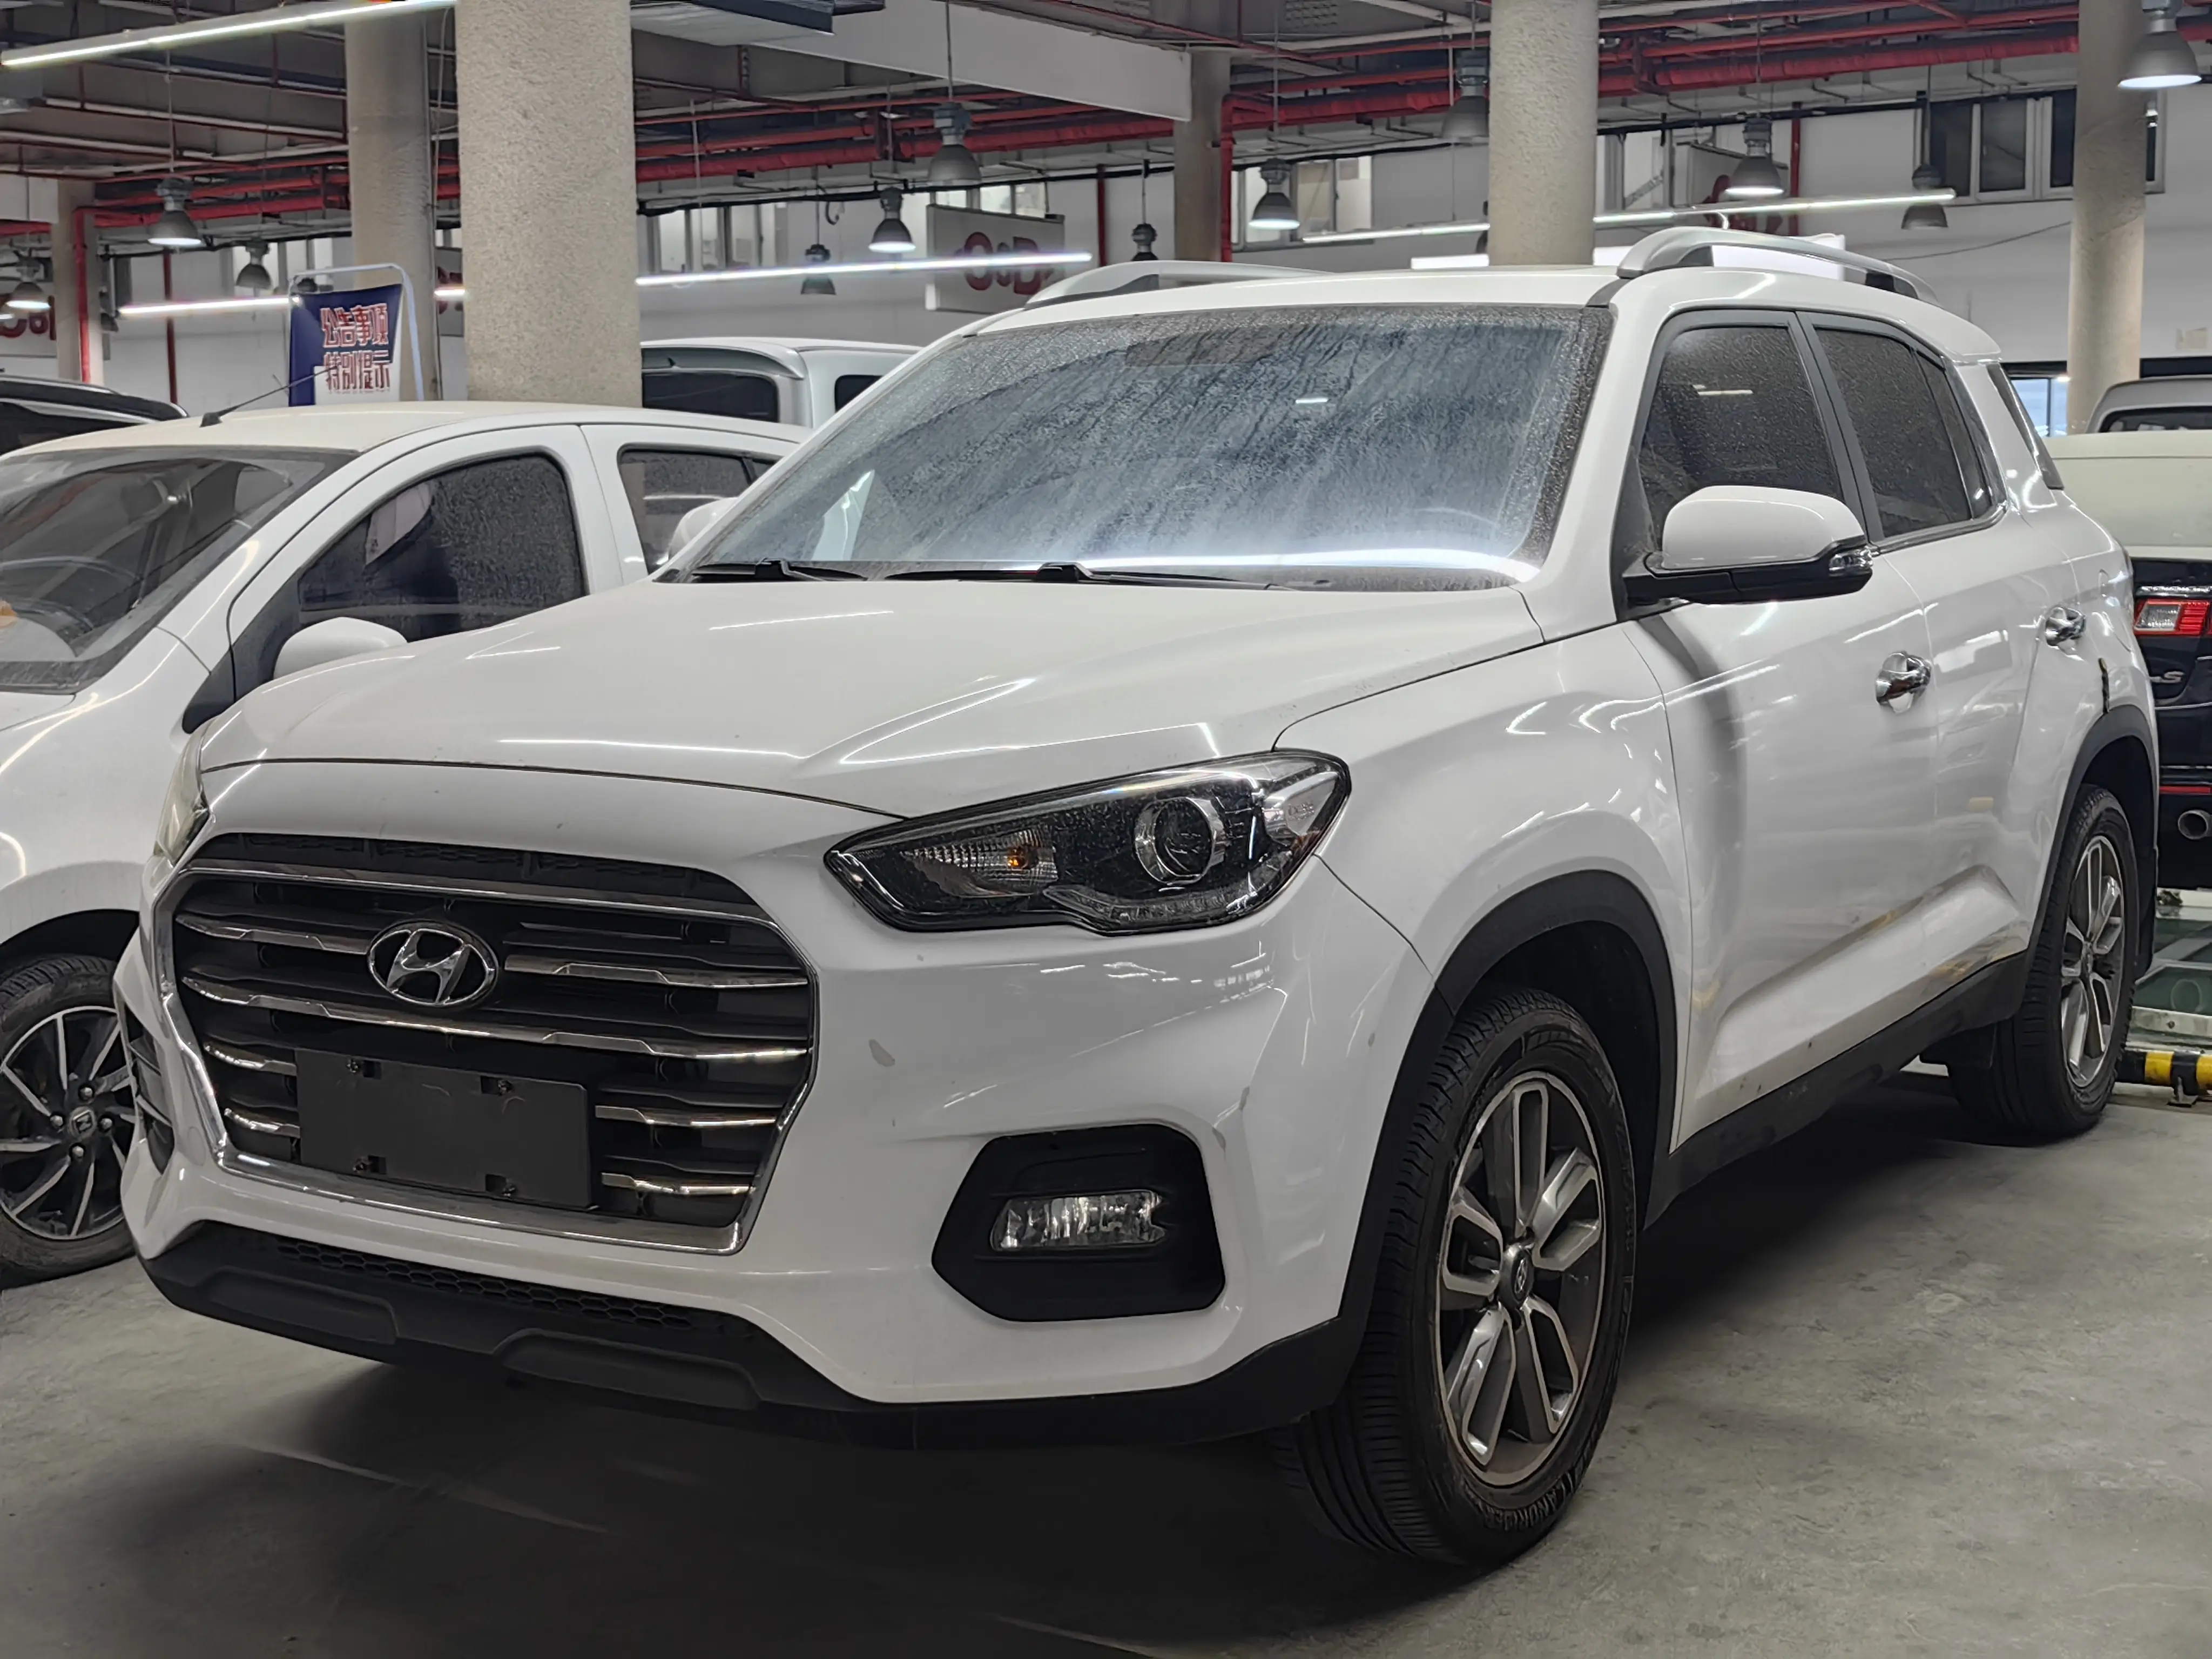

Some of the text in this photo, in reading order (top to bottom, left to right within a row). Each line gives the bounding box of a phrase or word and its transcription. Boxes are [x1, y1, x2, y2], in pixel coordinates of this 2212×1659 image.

[320, 302, 389, 348] 公告事项
[323, 350, 390, 393] 特别提示
